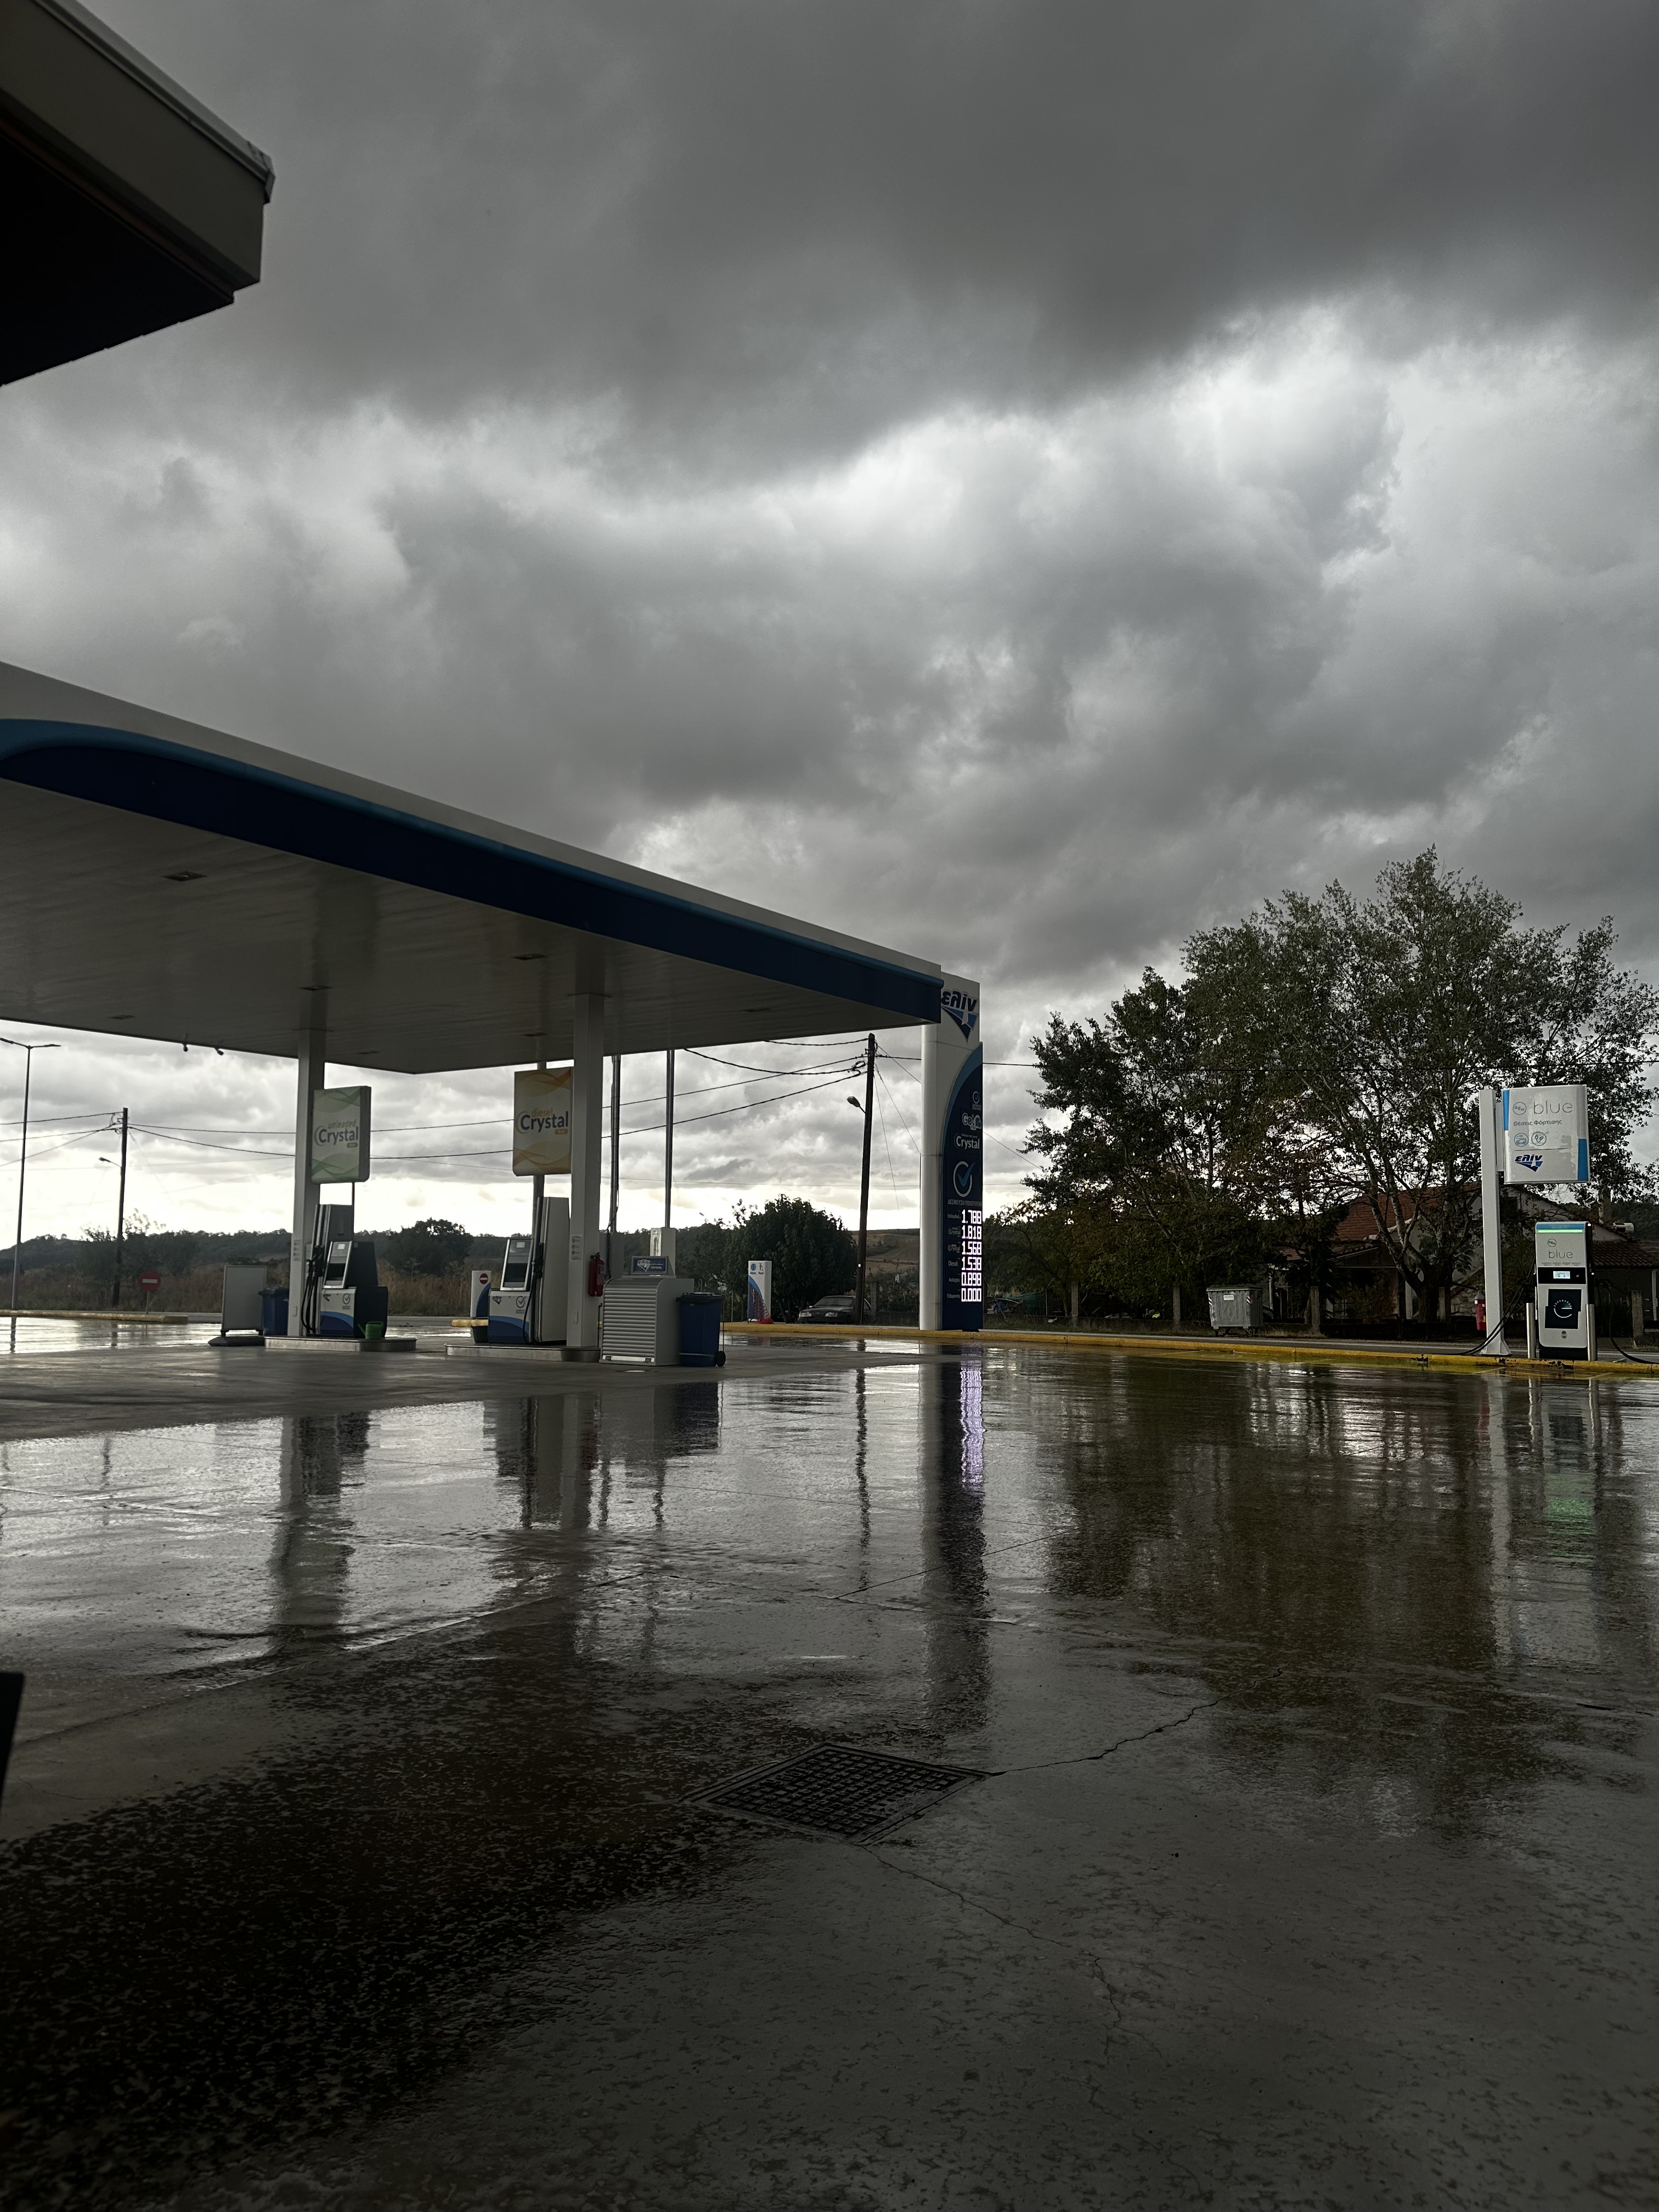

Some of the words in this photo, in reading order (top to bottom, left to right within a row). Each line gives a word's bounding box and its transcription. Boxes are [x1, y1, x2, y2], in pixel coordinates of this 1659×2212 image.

[531, 1107, 554, 1117] diesel
[1533, 1100, 1573, 1114] blue
[520, 1110, 569, 1133] Crystal
[319, 1126, 359, 1146] Crystal
[956, 1136, 980, 1150] Crystal
[962, 1209, 982, 1224] 1.788
[962, 1225, 982, 1239] 1.818
[962, 1241, 982, 1255] 1.568
[1548, 1250, 1573, 1259] blue
[961, 1256, 982, 1271] 1.538
[961, 1272, 982, 1286] 0.898
[961, 1288, 982, 1302] 0.000
